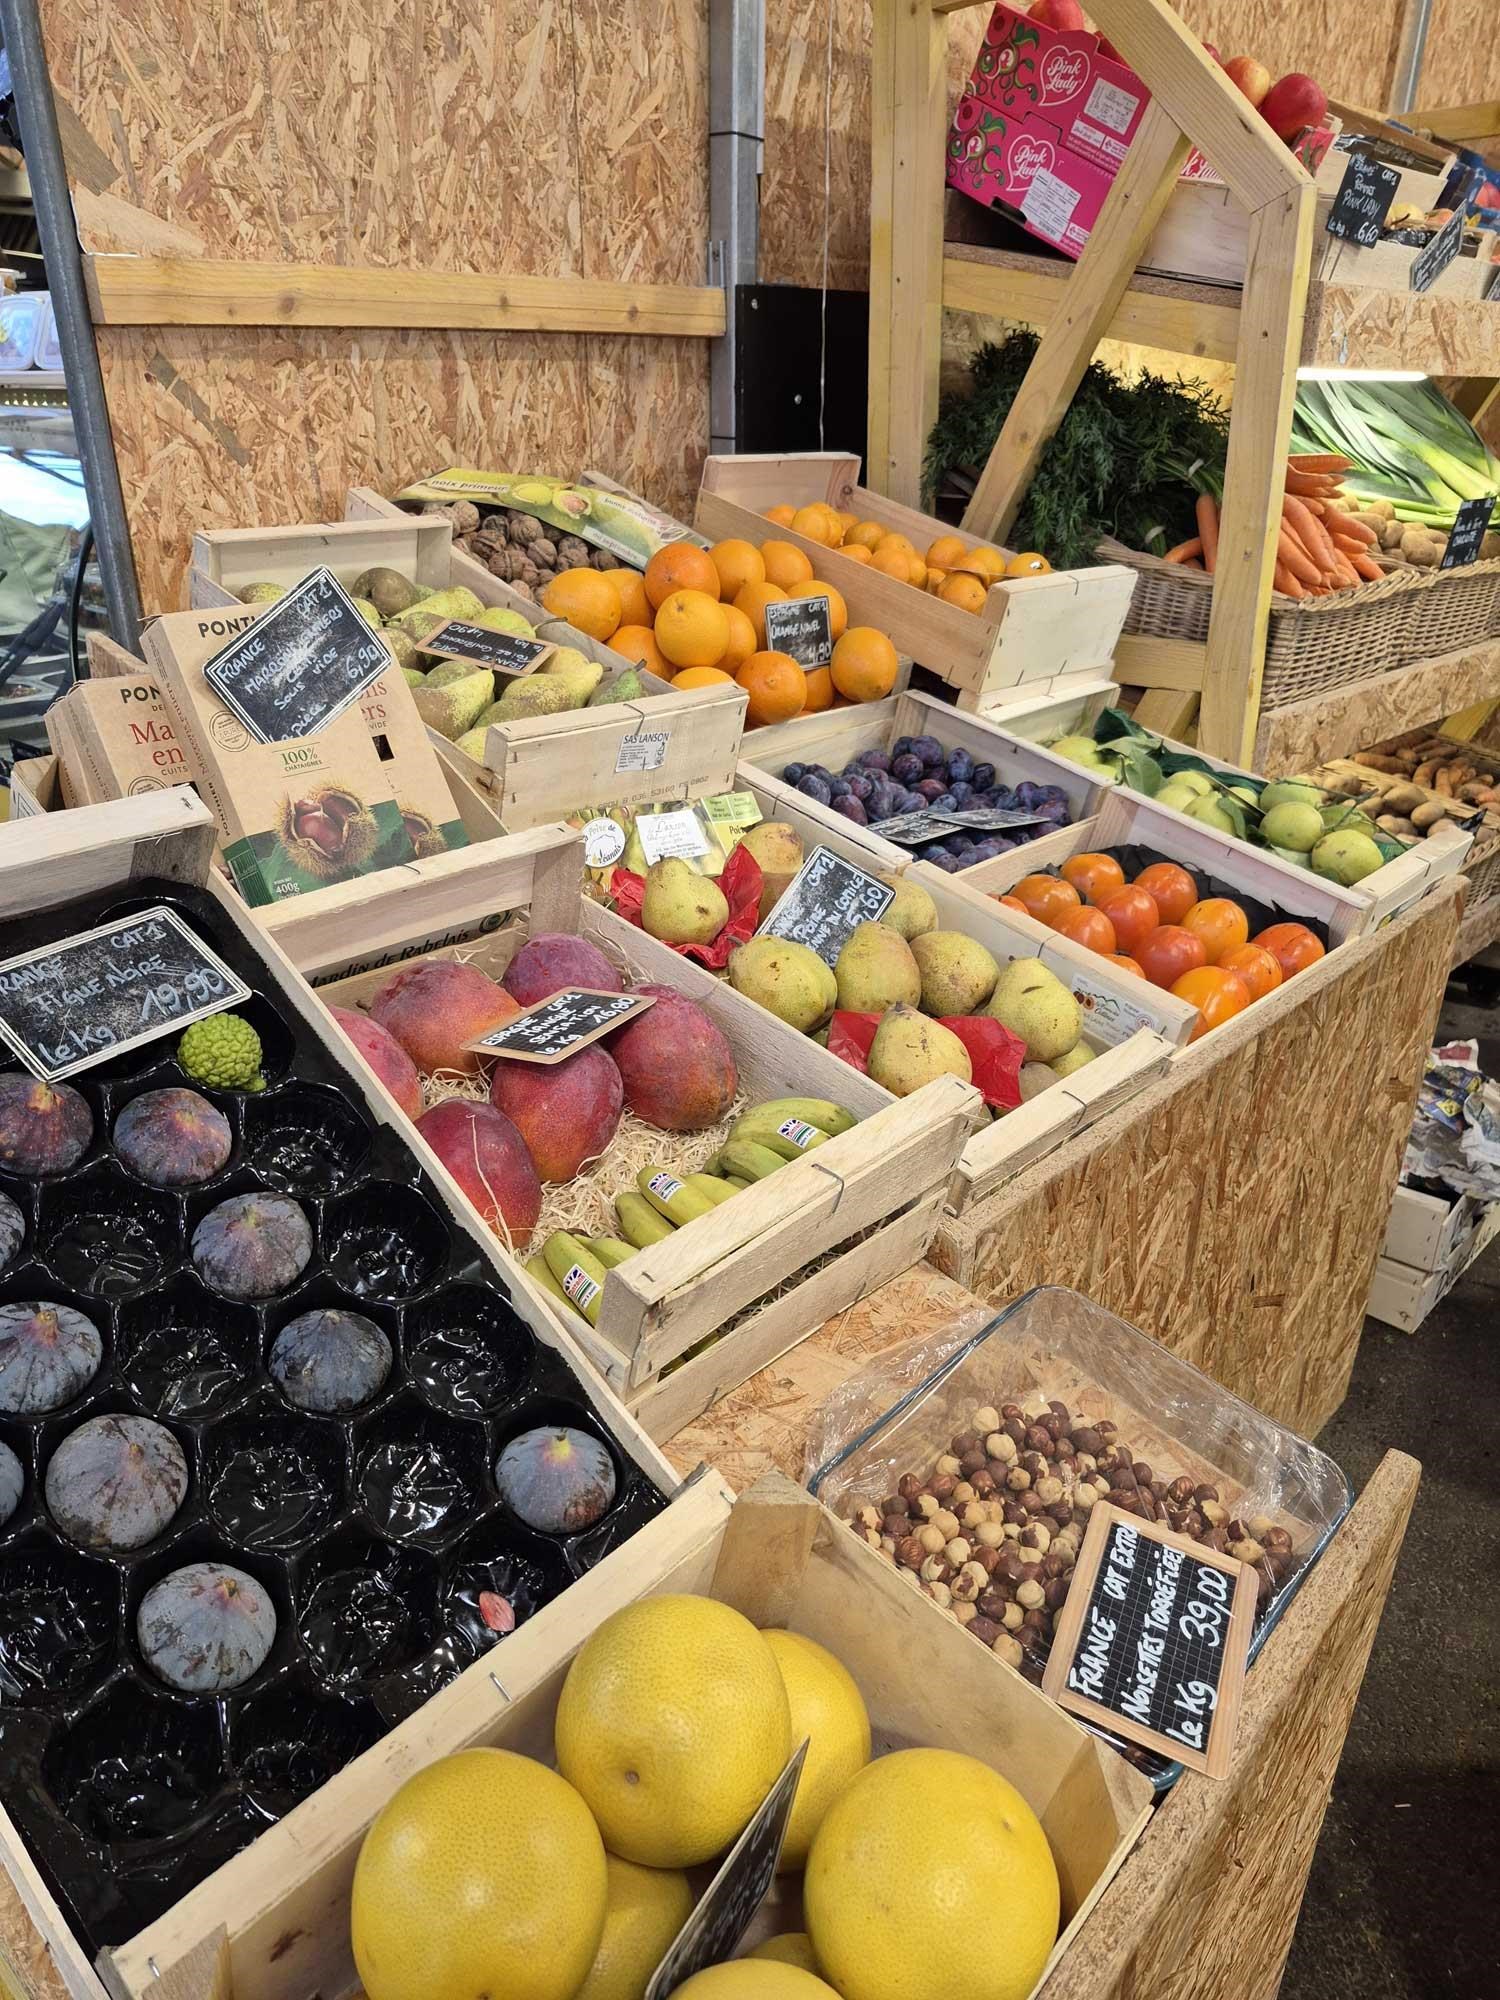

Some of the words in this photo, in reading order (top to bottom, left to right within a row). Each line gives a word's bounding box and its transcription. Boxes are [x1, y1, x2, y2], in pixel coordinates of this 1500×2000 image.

[1046, 55, 1082, 76] Pink
[1045, 73, 1079, 95] Lady
[1014, 145, 1047, 163] Pink
[1013, 162, 1041, 180] Lad
[431, 479, 457, 488] noix
[459, 482, 508, 493] primeur
[769, 605, 801, 619] ESPAGNE
[215, 638, 266, 684] FRANCE
[345, 644, 380, 680] 6,90
[360, 681, 388, 699] ns
[361, 704, 387, 720] rs
[368, 720, 388, 730] VIDE
[623, 734, 638, 745] SAS
[639, 732, 670, 744] LANSON
[280, 747, 319, 766] 100%
[160, 765, 189, 777] CUITS
[275, 881, 300, 895] 400g
[110, 927, 146, 950] CAT
[374, 952, 394, 969] de
[399, 928, 470, 961] Rabelais
[140, 967, 224, 1022] 19,90
[480, 1016, 538, 1047] ESPAGNE
[520, 1007, 577, 1037] MANGUE
[1178, 1566, 1237, 1648] 39,00
[1068, 1606, 1118, 1700] FRANCE
[1102, 1565, 1130, 1600] CAT
